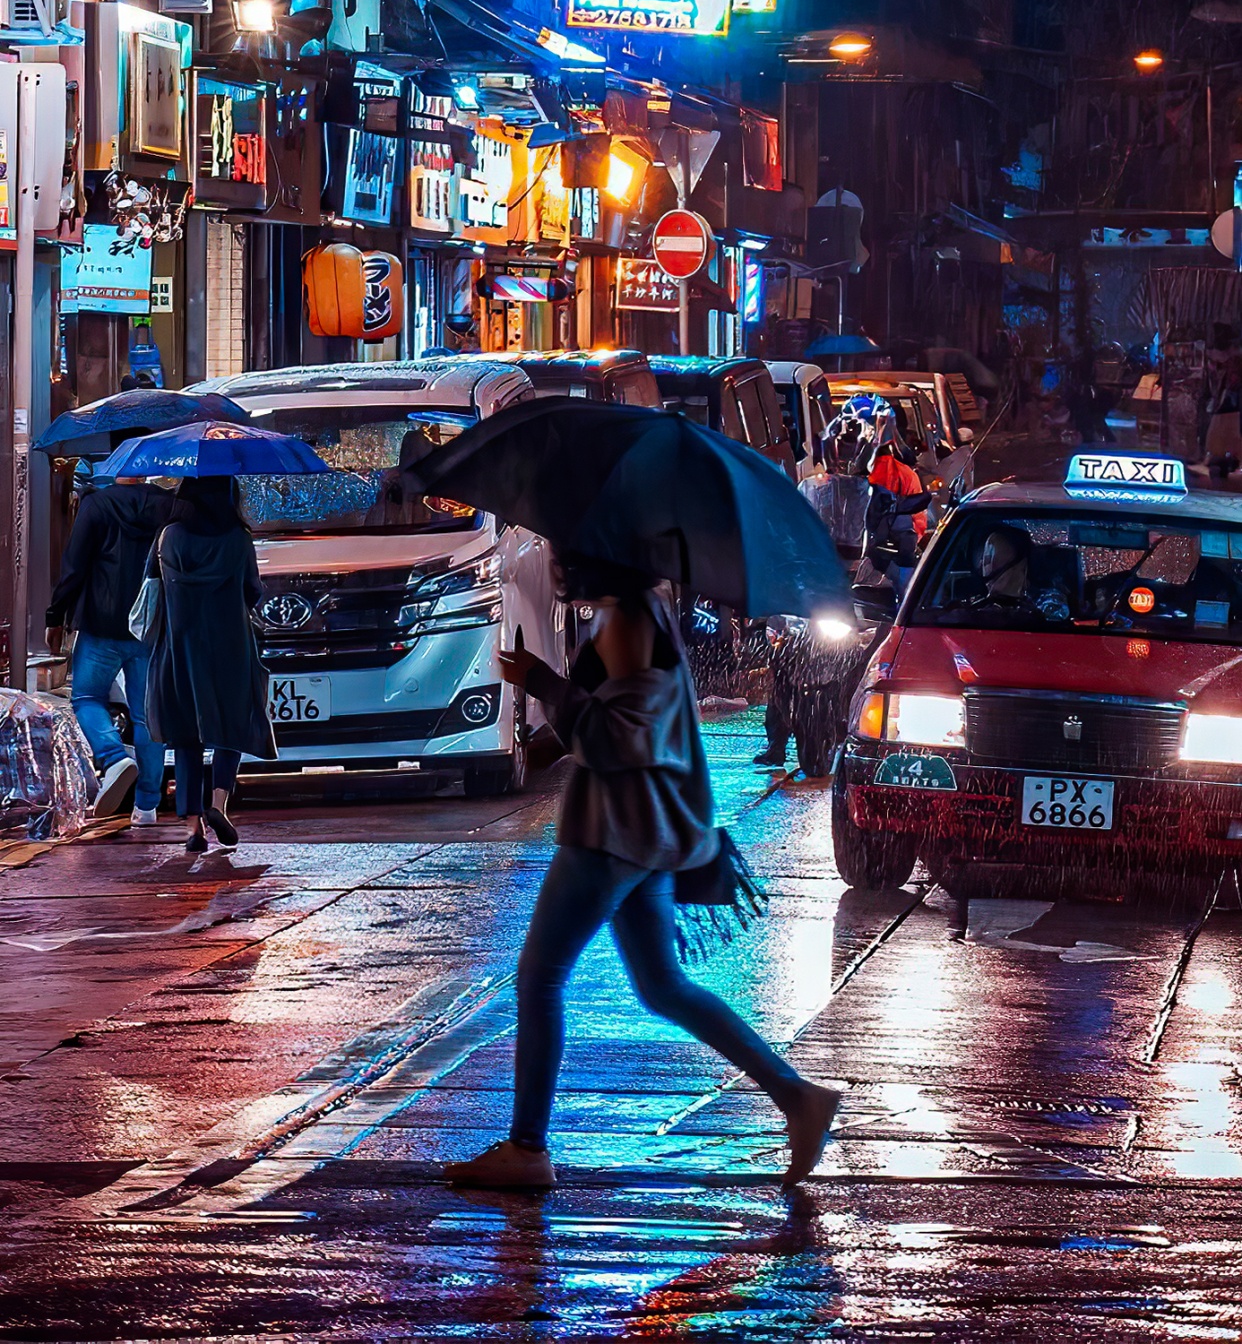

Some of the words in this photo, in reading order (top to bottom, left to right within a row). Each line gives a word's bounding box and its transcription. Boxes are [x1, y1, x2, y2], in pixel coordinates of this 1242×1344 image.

[1079, 459, 1174, 483] TAXI
[273, 680, 307, 701] KL
[1049, 779, 1089, 804] PX
[1029, 801, 1106, 827] 6866
